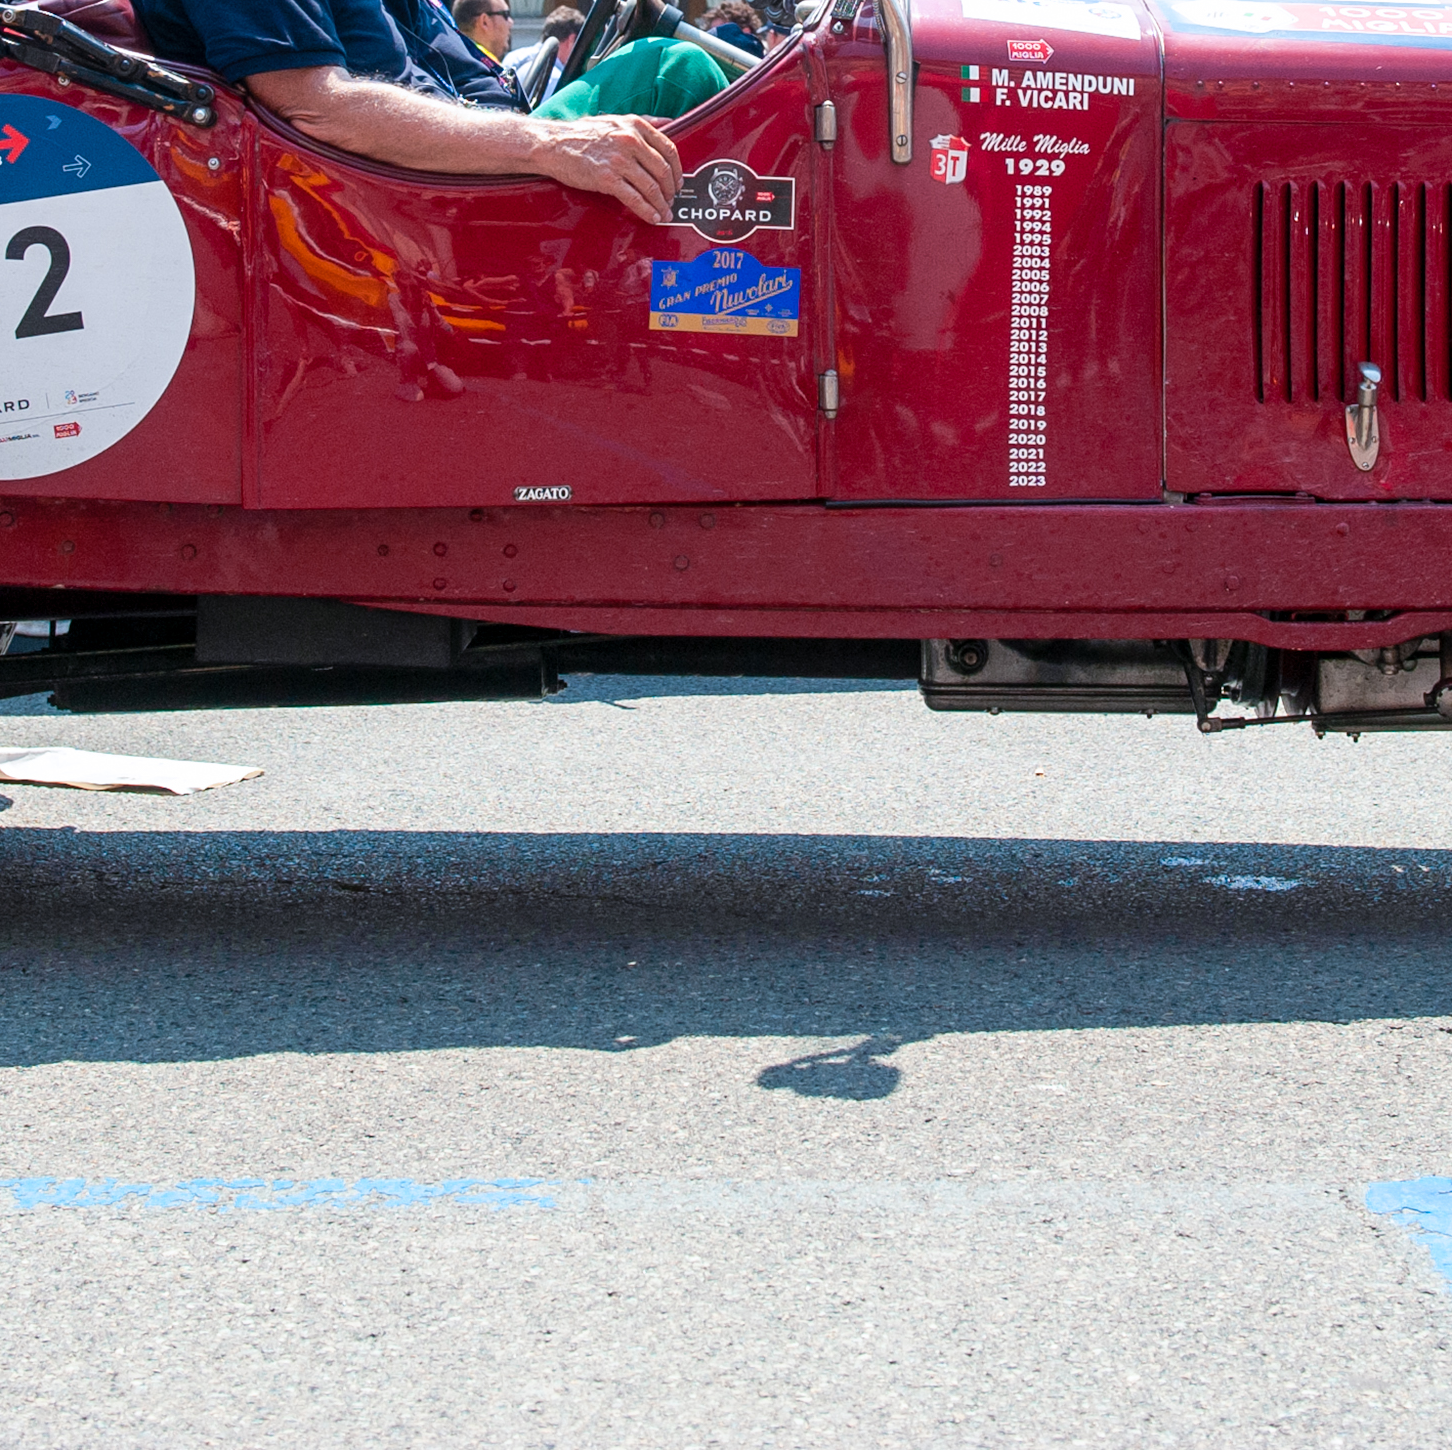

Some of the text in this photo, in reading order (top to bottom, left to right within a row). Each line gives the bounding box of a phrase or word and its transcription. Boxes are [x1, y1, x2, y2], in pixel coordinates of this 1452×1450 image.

[1319, 6, 1444, 21] 1000
[1011, 42, 1041, 51] 1000
[1011, 51, 1045, 60] MIGLIA
[991, 68, 1135, 97] M. AMENDUNI
[995, 88, 1090, 111] F. VICARI
[980, 132, 1090, 159] Mille Miglia
[1005, 158, 1066, 177] 1929
[1016, 185, 1052, 196] 1989
[1015, 197, 1050, 208] 1991
[678, 207, 772, 222] CHOPARD
[1015, 209, 1052, 220] 1992
[1015, 221, 1052, 232] 1994
[1014, 233, 1052, 245] 1995
[1013, 245, 1050, 256] 2003
[712, 250, 744, 270] 2017
[1012, 257, 1050, 268] 2004
[1012, 269, 1050, 281] 2005
[658, 272, 738, 310] GRAN PREMIO
[1012, 281, 1050, 292] 2006
[1012, 293, 1049, 304] 2007
[1011, 305, 1049, 316] 2008
[1011, 317, 1047, 328] 2011
[1010, 329, 1048, 340] 2012
[1010, 341, 1047, 352] 2013
[1009, 353, 1047, 364] 2014
[1009, 365, 1046, 377] 2015
[1009, 378, 1046, 389] 2016
[1009, 391, 1046, 401] 2017
[1009, 404, 1046, 416] 2018
[1009, 419, 1047, 430] 2019
[1008, 434, 1046, 445] 2020
[1009, 448, 1044, 459] 2021
[1008, 462, 1046, 472] 2022
[1009, 476, 1046, 486] 2023
[518, 487, 569, 500] ZAGATO
